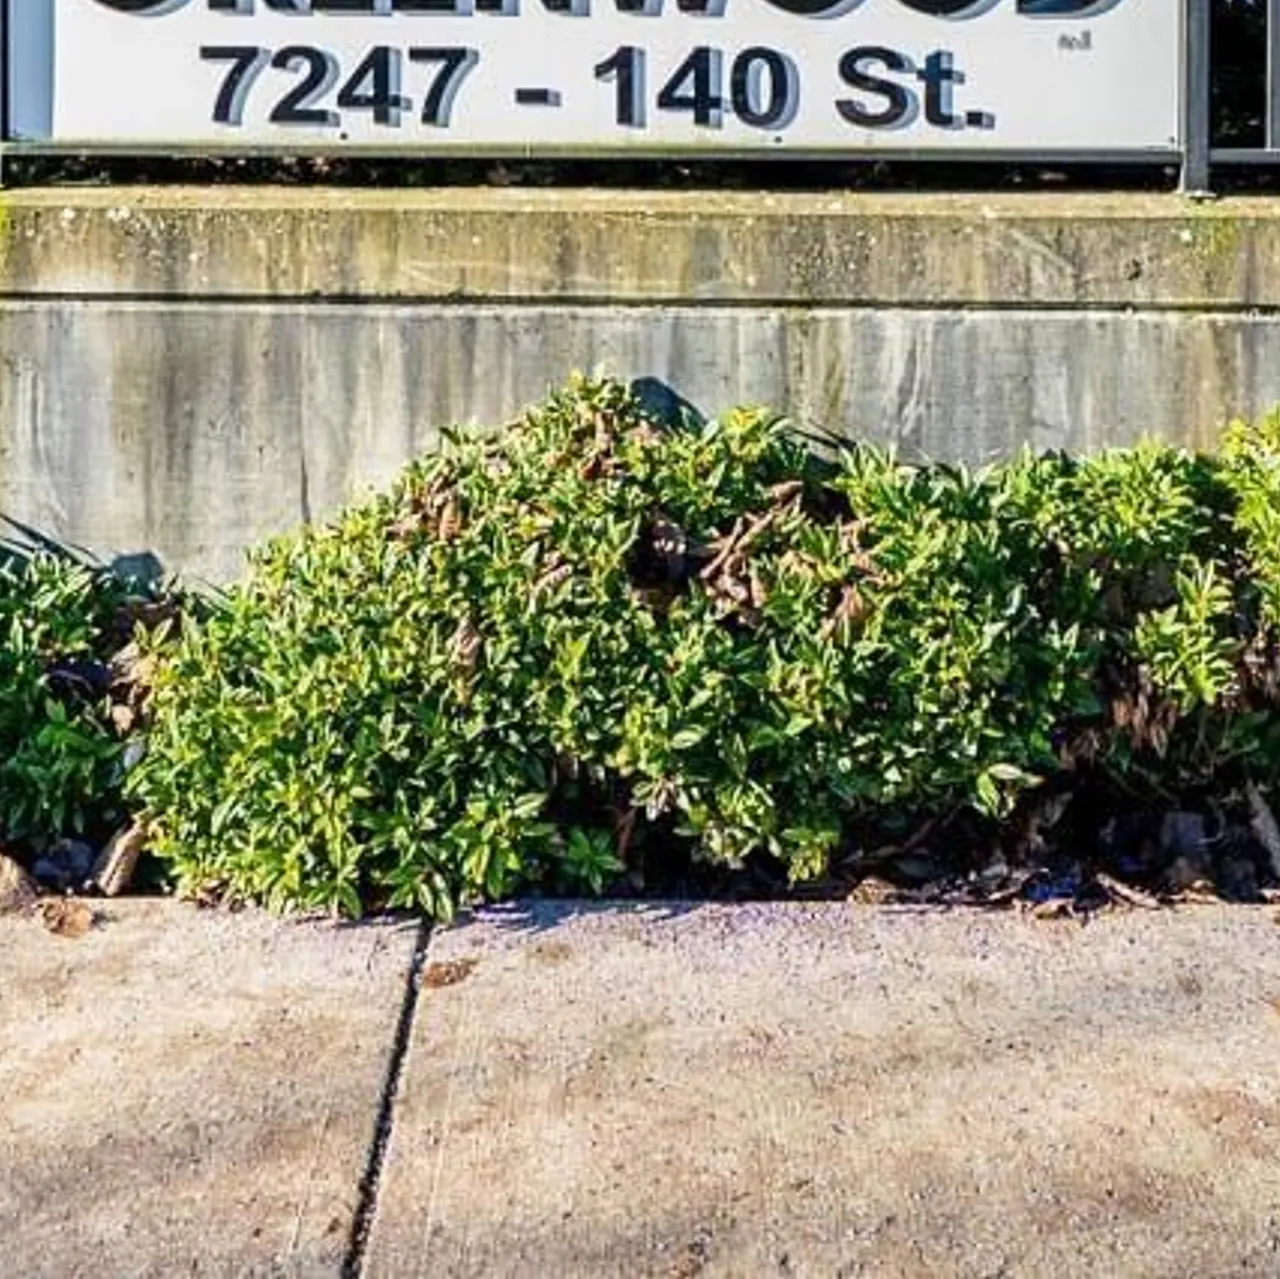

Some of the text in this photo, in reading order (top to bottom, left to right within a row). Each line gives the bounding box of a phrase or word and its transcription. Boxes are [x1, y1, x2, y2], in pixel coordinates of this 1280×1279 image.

[199, 45, 986, 128] 7247 - 140 St.
